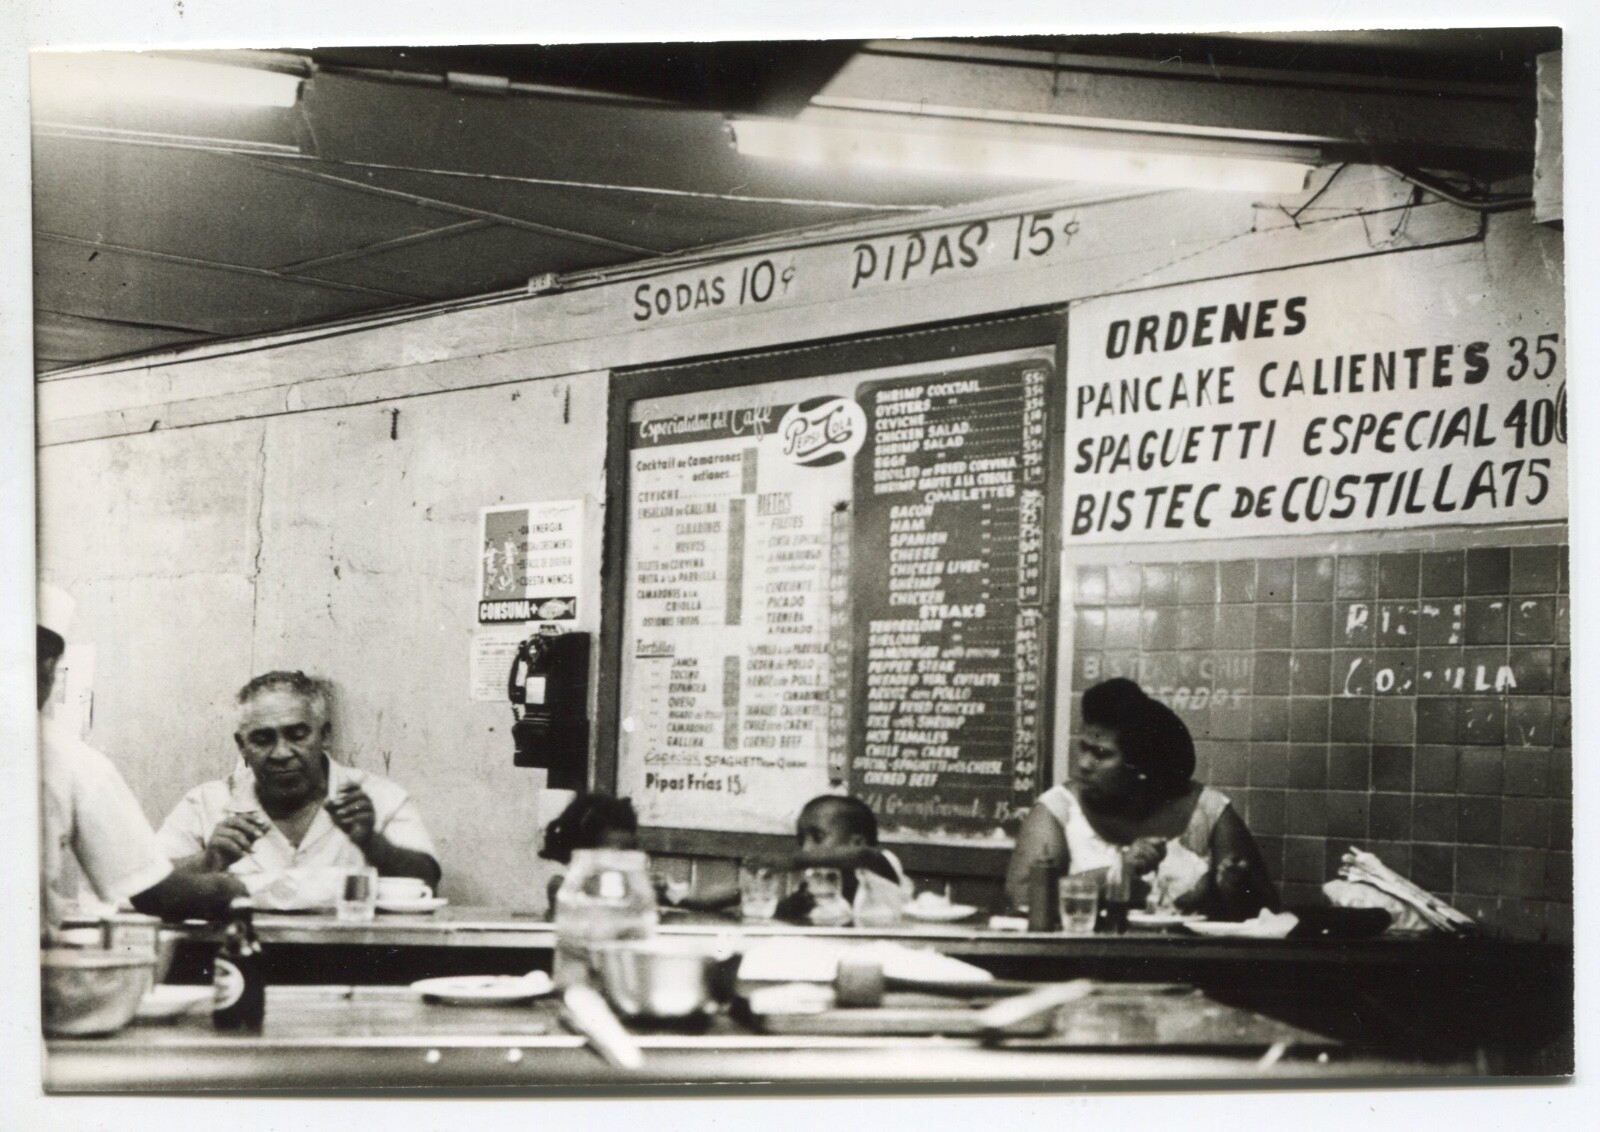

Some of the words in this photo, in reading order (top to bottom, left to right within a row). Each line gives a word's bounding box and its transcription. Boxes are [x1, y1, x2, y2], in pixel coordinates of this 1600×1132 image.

[852, 221, 990, 290] PIPAS
[633, 276, 725, 321] SODAS
[1105, 296, 1308, 359] ORDENES
[1076, 366, 1236, 419] PANCAKE
[1259, 341, 1490, 399] CALIENTES
[1507, 333, 1559, 381] 35
[876, 386, 924, 404] SHRIMP
[927, 380, 981, 398] COCKTAIL
[928, 421, 970, 438] SALAD
[1074, 419, 1276, 474] SPAGUETTI
[1304, 402, 1497, 456] ESPECIAL
[922, 435, 965, 451] SALAD
[636, 459, 676, 472] Cocktail
[688, 452, 742, 467] Camarones
[638, 490, 680, 504] CEVICHE
[1071, 483, 1222, 536] BISTEC
[1230, 485, 1276, 519] DE
[1281, 460, 1499, 522] COSTILLA
[1500, 457, 1552, 507] 75
[889, 518, 926, 533] HAM
[480, 600, 531, 620] CONSUMA
[919, 603, 987, 620] STEAKS
[645, 772, 684, 793] Pipas
[687, 771, 723, 791] Frías
